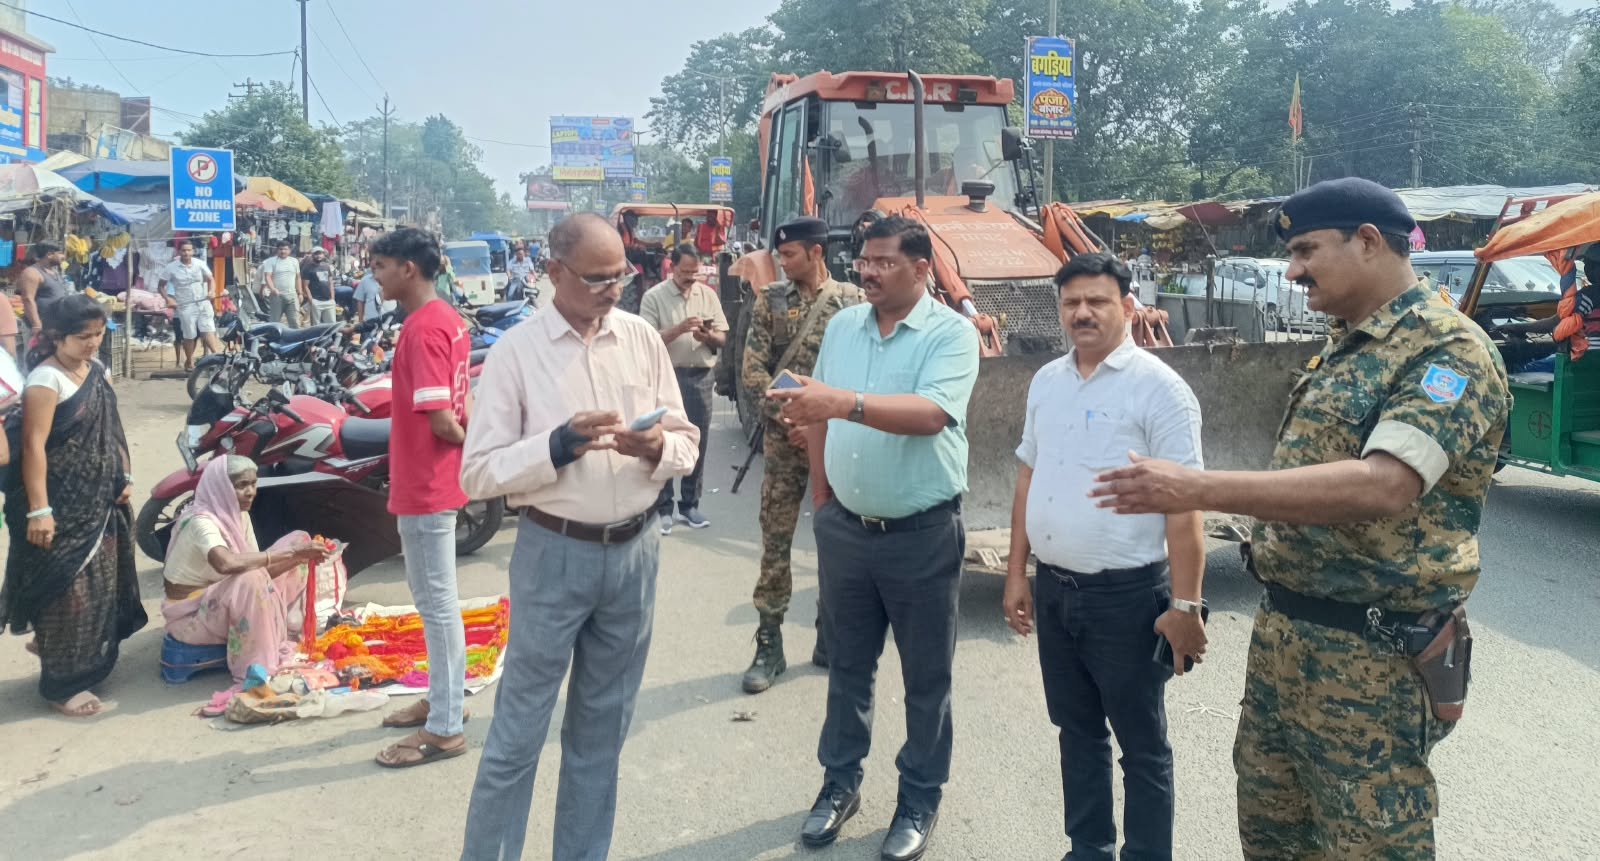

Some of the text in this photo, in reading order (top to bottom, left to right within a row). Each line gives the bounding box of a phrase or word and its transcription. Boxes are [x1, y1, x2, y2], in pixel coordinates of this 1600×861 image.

[195, 186, 213, 197] NO
[176, 198, 231, 210] PARKING
[188, 211, 221, 222] ZONE
